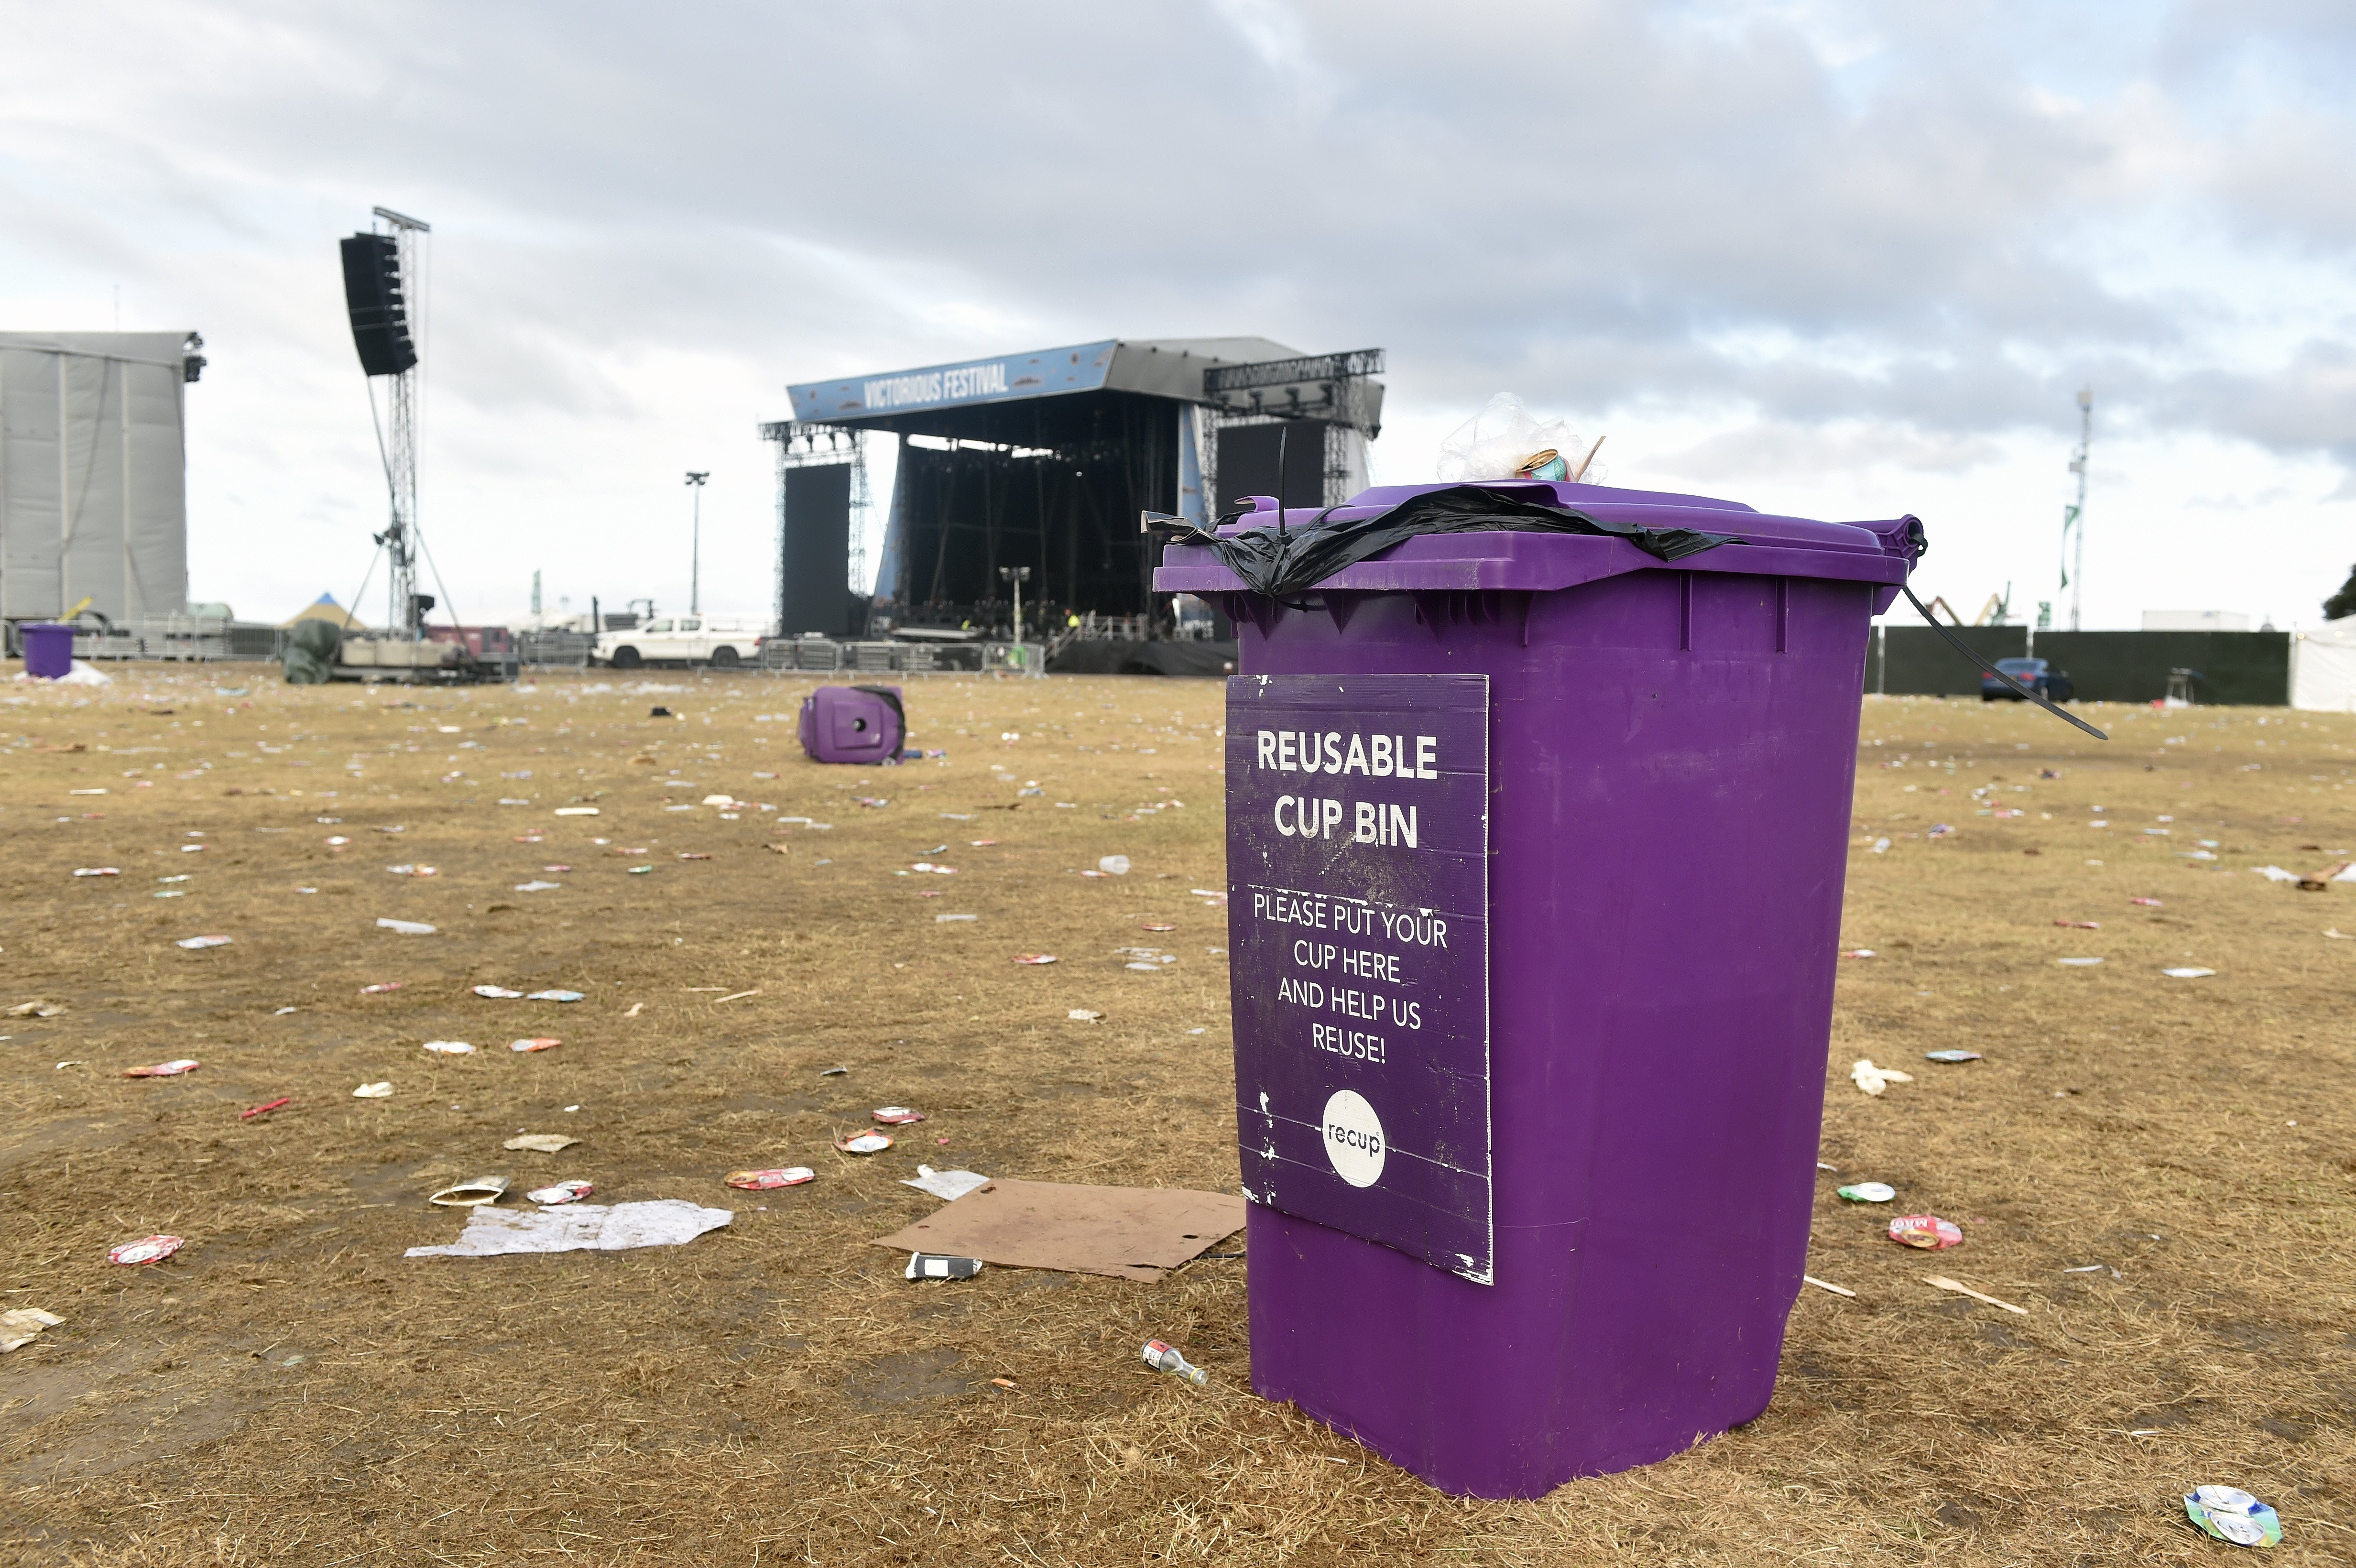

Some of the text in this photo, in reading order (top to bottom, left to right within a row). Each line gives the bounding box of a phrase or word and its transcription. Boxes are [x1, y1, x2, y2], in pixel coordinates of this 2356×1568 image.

[864, 362, 1009, 409] VICTORIOUS FESTIVAL
[1258, 730, 1438, 780] REUSABLE
[1274, 795, 1418, 849] CUP BIN
[1254, 893, 1447, 948] PLEASE PUT YOUR
[1294, 939, 1400, 983] CUP HERE
[1278, 977, 1421, 1030] AND HELP US
[1312, 1023, 1385, 1064] REUSE!
[1329, 1123, 1380, 1157] recup
